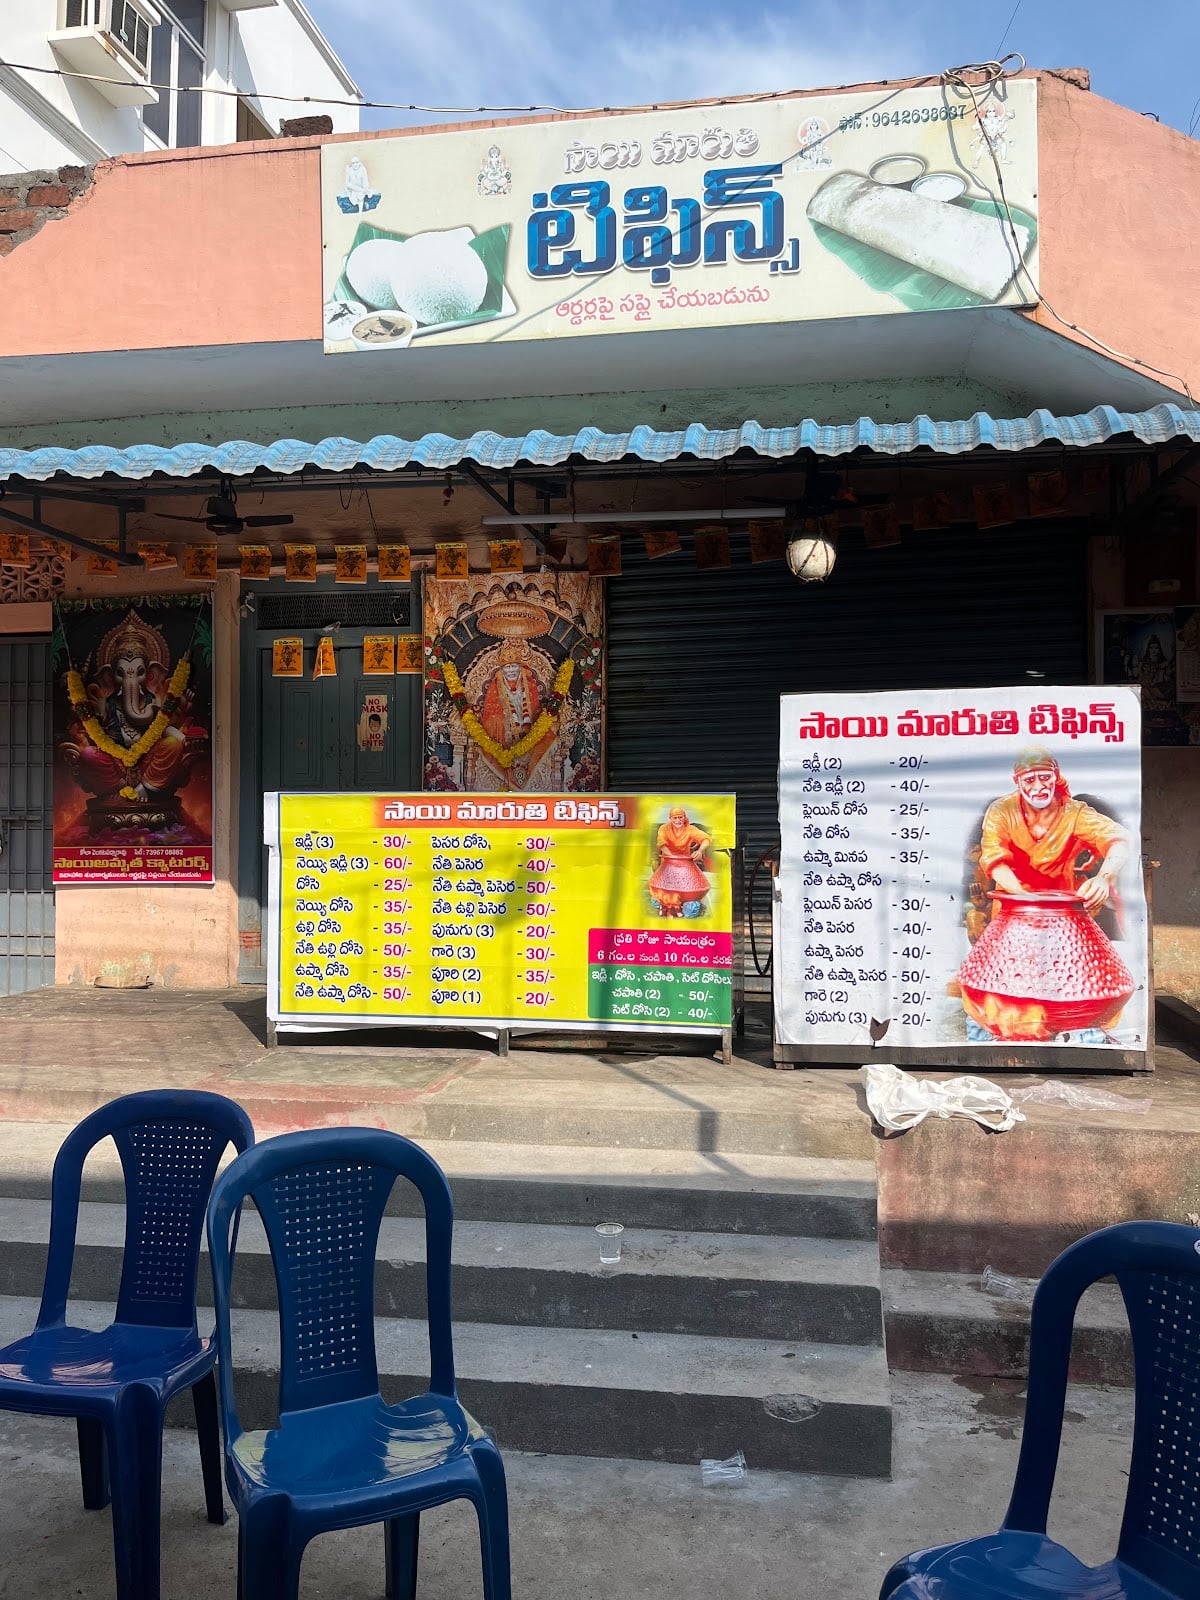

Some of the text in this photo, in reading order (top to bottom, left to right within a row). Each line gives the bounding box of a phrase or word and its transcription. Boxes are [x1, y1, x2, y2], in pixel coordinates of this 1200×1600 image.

[872, 105, 966, 128] 9642638637
[564, 126, 760, 173] సాయి మారుతి
[528, 163, 801, 285] టిఫిన్స్
[657, 286, 770, 309] చేయబడును
[800, 703, 1124, 743] సాయి మారుతి టిఫిన్స్
[824, 758, 842, 770] (2)
[899, 755, 928, 769] 20/-
[803, 777, 822, 792] నేతి
[847, 781, 865, 793] (2)
[900, 779, 929, 793] 40/-
[384, 800, 625, 828] సాయి మారుతి టిఫిన్స్
[844, 801, 867, 815] దోస
[900, 802, 929, 817] 25/-
[803, 824, 930, 841] నేతి దోస 35/-
[316, 836, 334, 848] (3)
[384, 834, 411, 849] 30/-
[526, 837, 555, 851] 30/-
[296, 856, 327, 873] నెయ్యి
[351, 858, 368, 870] (3)
[384, 856, 412, 870] 60/-
[433, 855, 452, 870] నేతి
[527, 858, 555, 873] 40/-
[803, 850, 928, 867] ఉప్మా మినప 35/-
[296, 875, 412, 892] దోసె 25/-
[433, 877, 452, 891] నేతి
[456, 879, 484, 897] ఉప్మా
[527, 881, 556, 895] 50/-
[804, 871, 881, 891] నేతి ఉప్మా దోస
[296, 897, 412, 916] నెయ్యి దోసె 35/-
[432, 898, 451, 913] నేతి
[456, 901, 474, 917] ఉల్లి
[527, 903, 555, 917] 50/-
[844, 898, 872, 909] పెసర
[901, 898, 930, 912] 30/-
[296, 918, 412, 936] ఉల్లి దోసె 35/-
[432, 923, 555, 939] పునుగు (3) 20/-
[804, 918, 932, 936] నేతి పెసర 40/-
[296, 939, 411, 958] నేతి ఉల్లి దోసె 50/-
[614, 932, 715, 948] ప్రతి రోజు సాయంత్రం
[458, 947, 475, 959] (3)
[526, 947, 555, 961] 30/-
[598, 950, 604, 960] 6
[664, 952, 677, 962] 10
[804, 944, 931, 961] ఉప్మా పెసర 40/-
[296, 962, 411, 981] ఉప్మా దోసె 35/-
[463, 969, 481, 981] (2)
[526, 969, 555, 984] 35/-
[805, 965, 930, 986] నేతి ఉప్మా పెసర 50/-
[295, 982, 411, 1003] నేతి ఉప్మా దోసె 50/-
[463, 991, 481, 1003] (1)
[525, 992, 554, 1006] 20/-
[612, 987, 713, 1002] చపాతి (2) 50/-
[830, 991, 848, 1003] (2)
[902, 991, 931, 1005] 20/-
[612, 1004, 712, 1019] సెట్ దోసె (2) 40/-
[806, 1010, 931, 1027] పునుగు (3) 20/-
